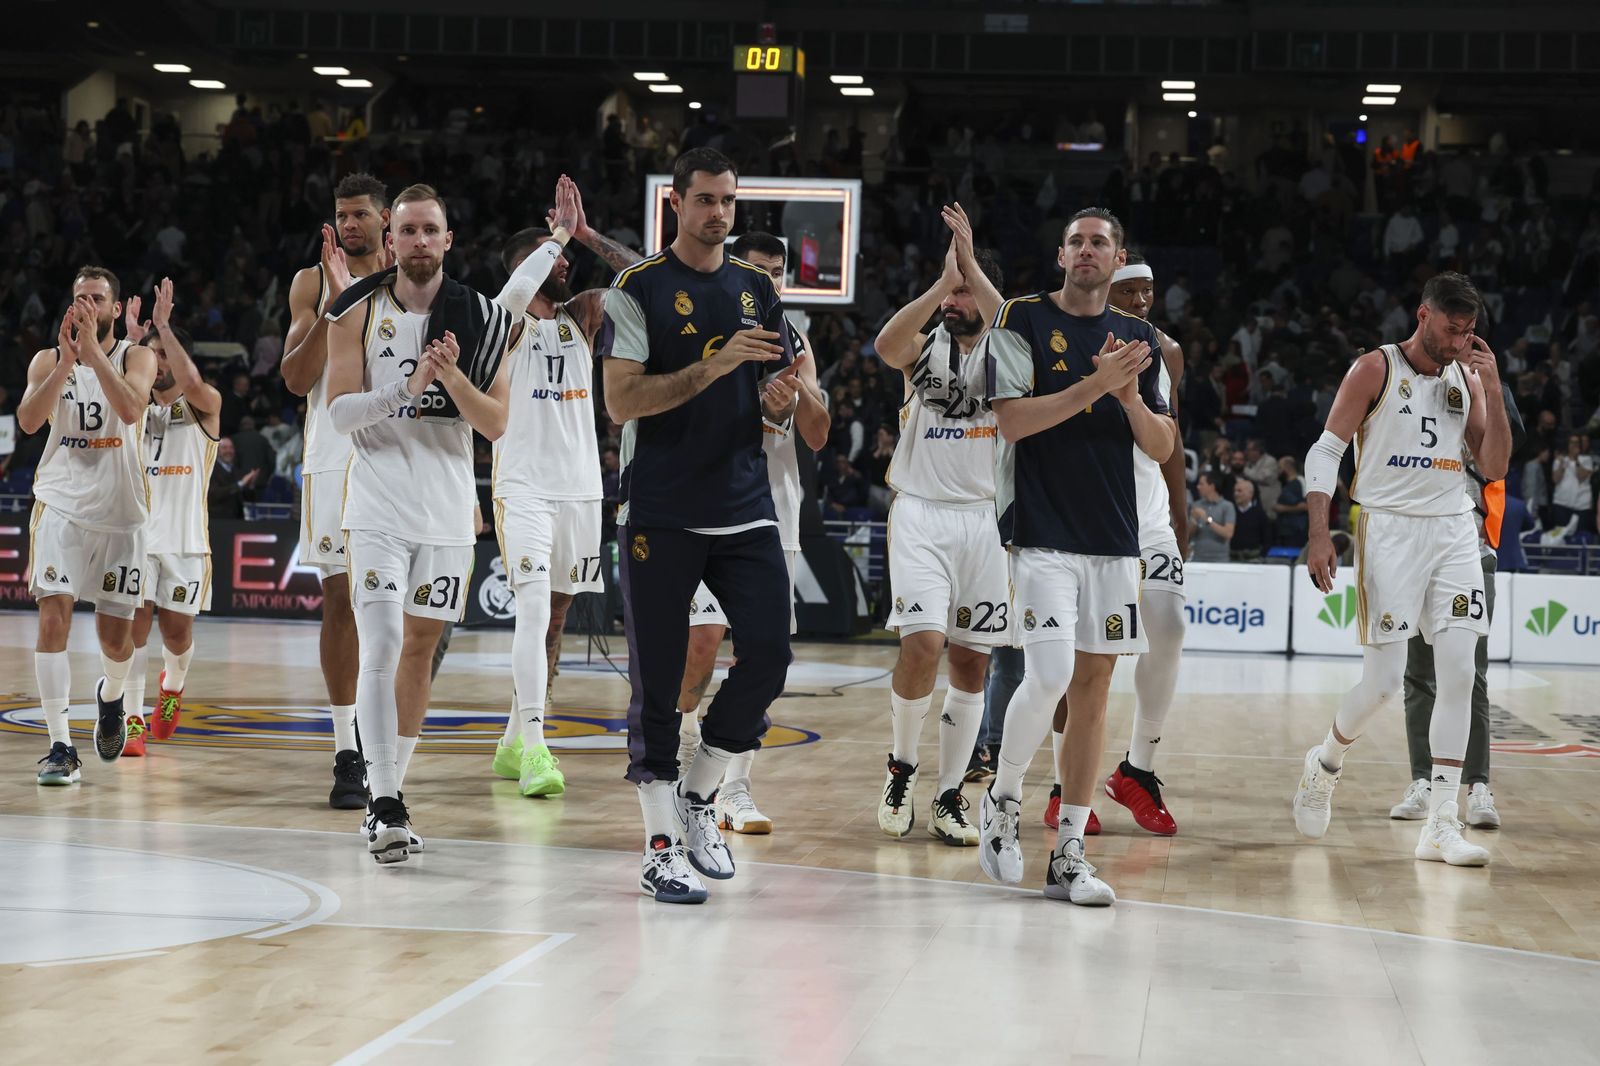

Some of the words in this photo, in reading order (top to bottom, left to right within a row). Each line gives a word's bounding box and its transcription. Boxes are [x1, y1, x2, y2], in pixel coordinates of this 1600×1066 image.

[544, 354, 565, 384] 17
[532, 388, 588, 402] AUTOHERO
[77, 401, 103, 432] 13
[924, 425, 997, 439] AUTOHER
[1420, 416, 1438, 449] 5
[153, 436, 164, 462] 7
[1386, 455, 1462, 472] AUTOHERO
[118, 565, 141, 595] 13
[581, 555, 601, 583] 17
[1148, 553, 1184, 586] 28
[188, 581, 200, 604] 7
[430, 575, 460, 609] 31
[1470, 588, 1484, 620] 5
[970, 601, 1008, 632] 23
[1124, 603, 1137, 639] 1
[1184, 599, 1265, 633] nicaja
